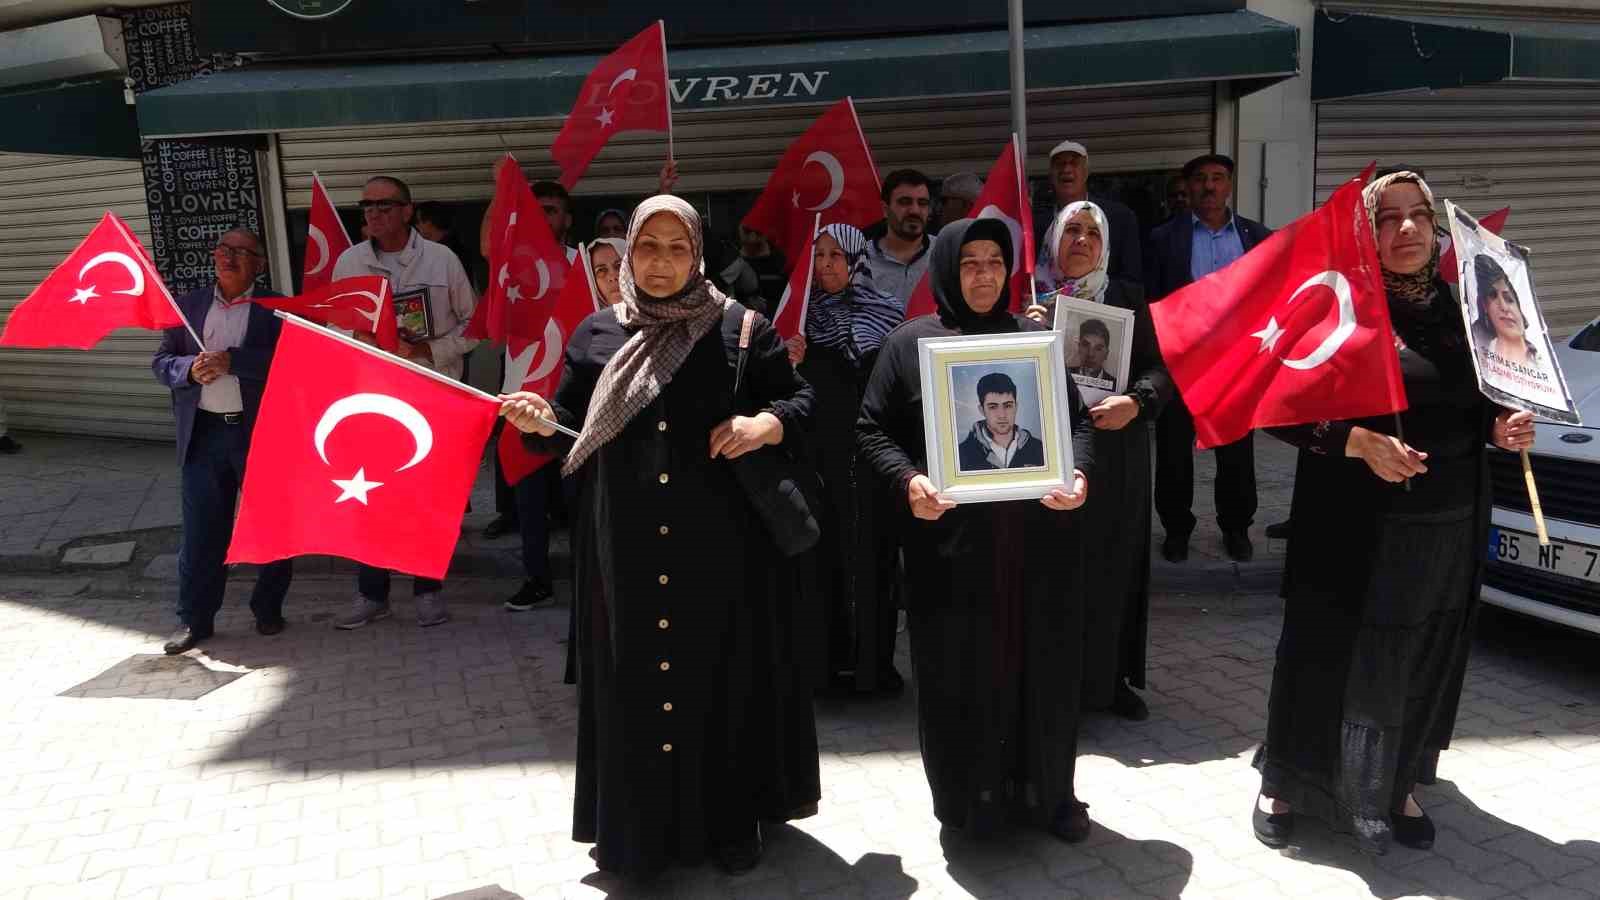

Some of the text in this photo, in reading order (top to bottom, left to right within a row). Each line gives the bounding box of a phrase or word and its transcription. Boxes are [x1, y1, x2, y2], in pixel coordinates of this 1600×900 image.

[139, 17, 190, 36] COFFEE
[142, 40, 158, 85] COFFEE
[142, 139, 164, 214] LOVREN
[159, 141, 176, 192] COFFEE
[223, 144, 240, 191] COFFEE
[171, 190, 258, 213] LOVREN
[174, 266, 216, 280] COFFE
[1498, 533, 1519, 560] 65
[1539, 544, 1563, 570] NF
